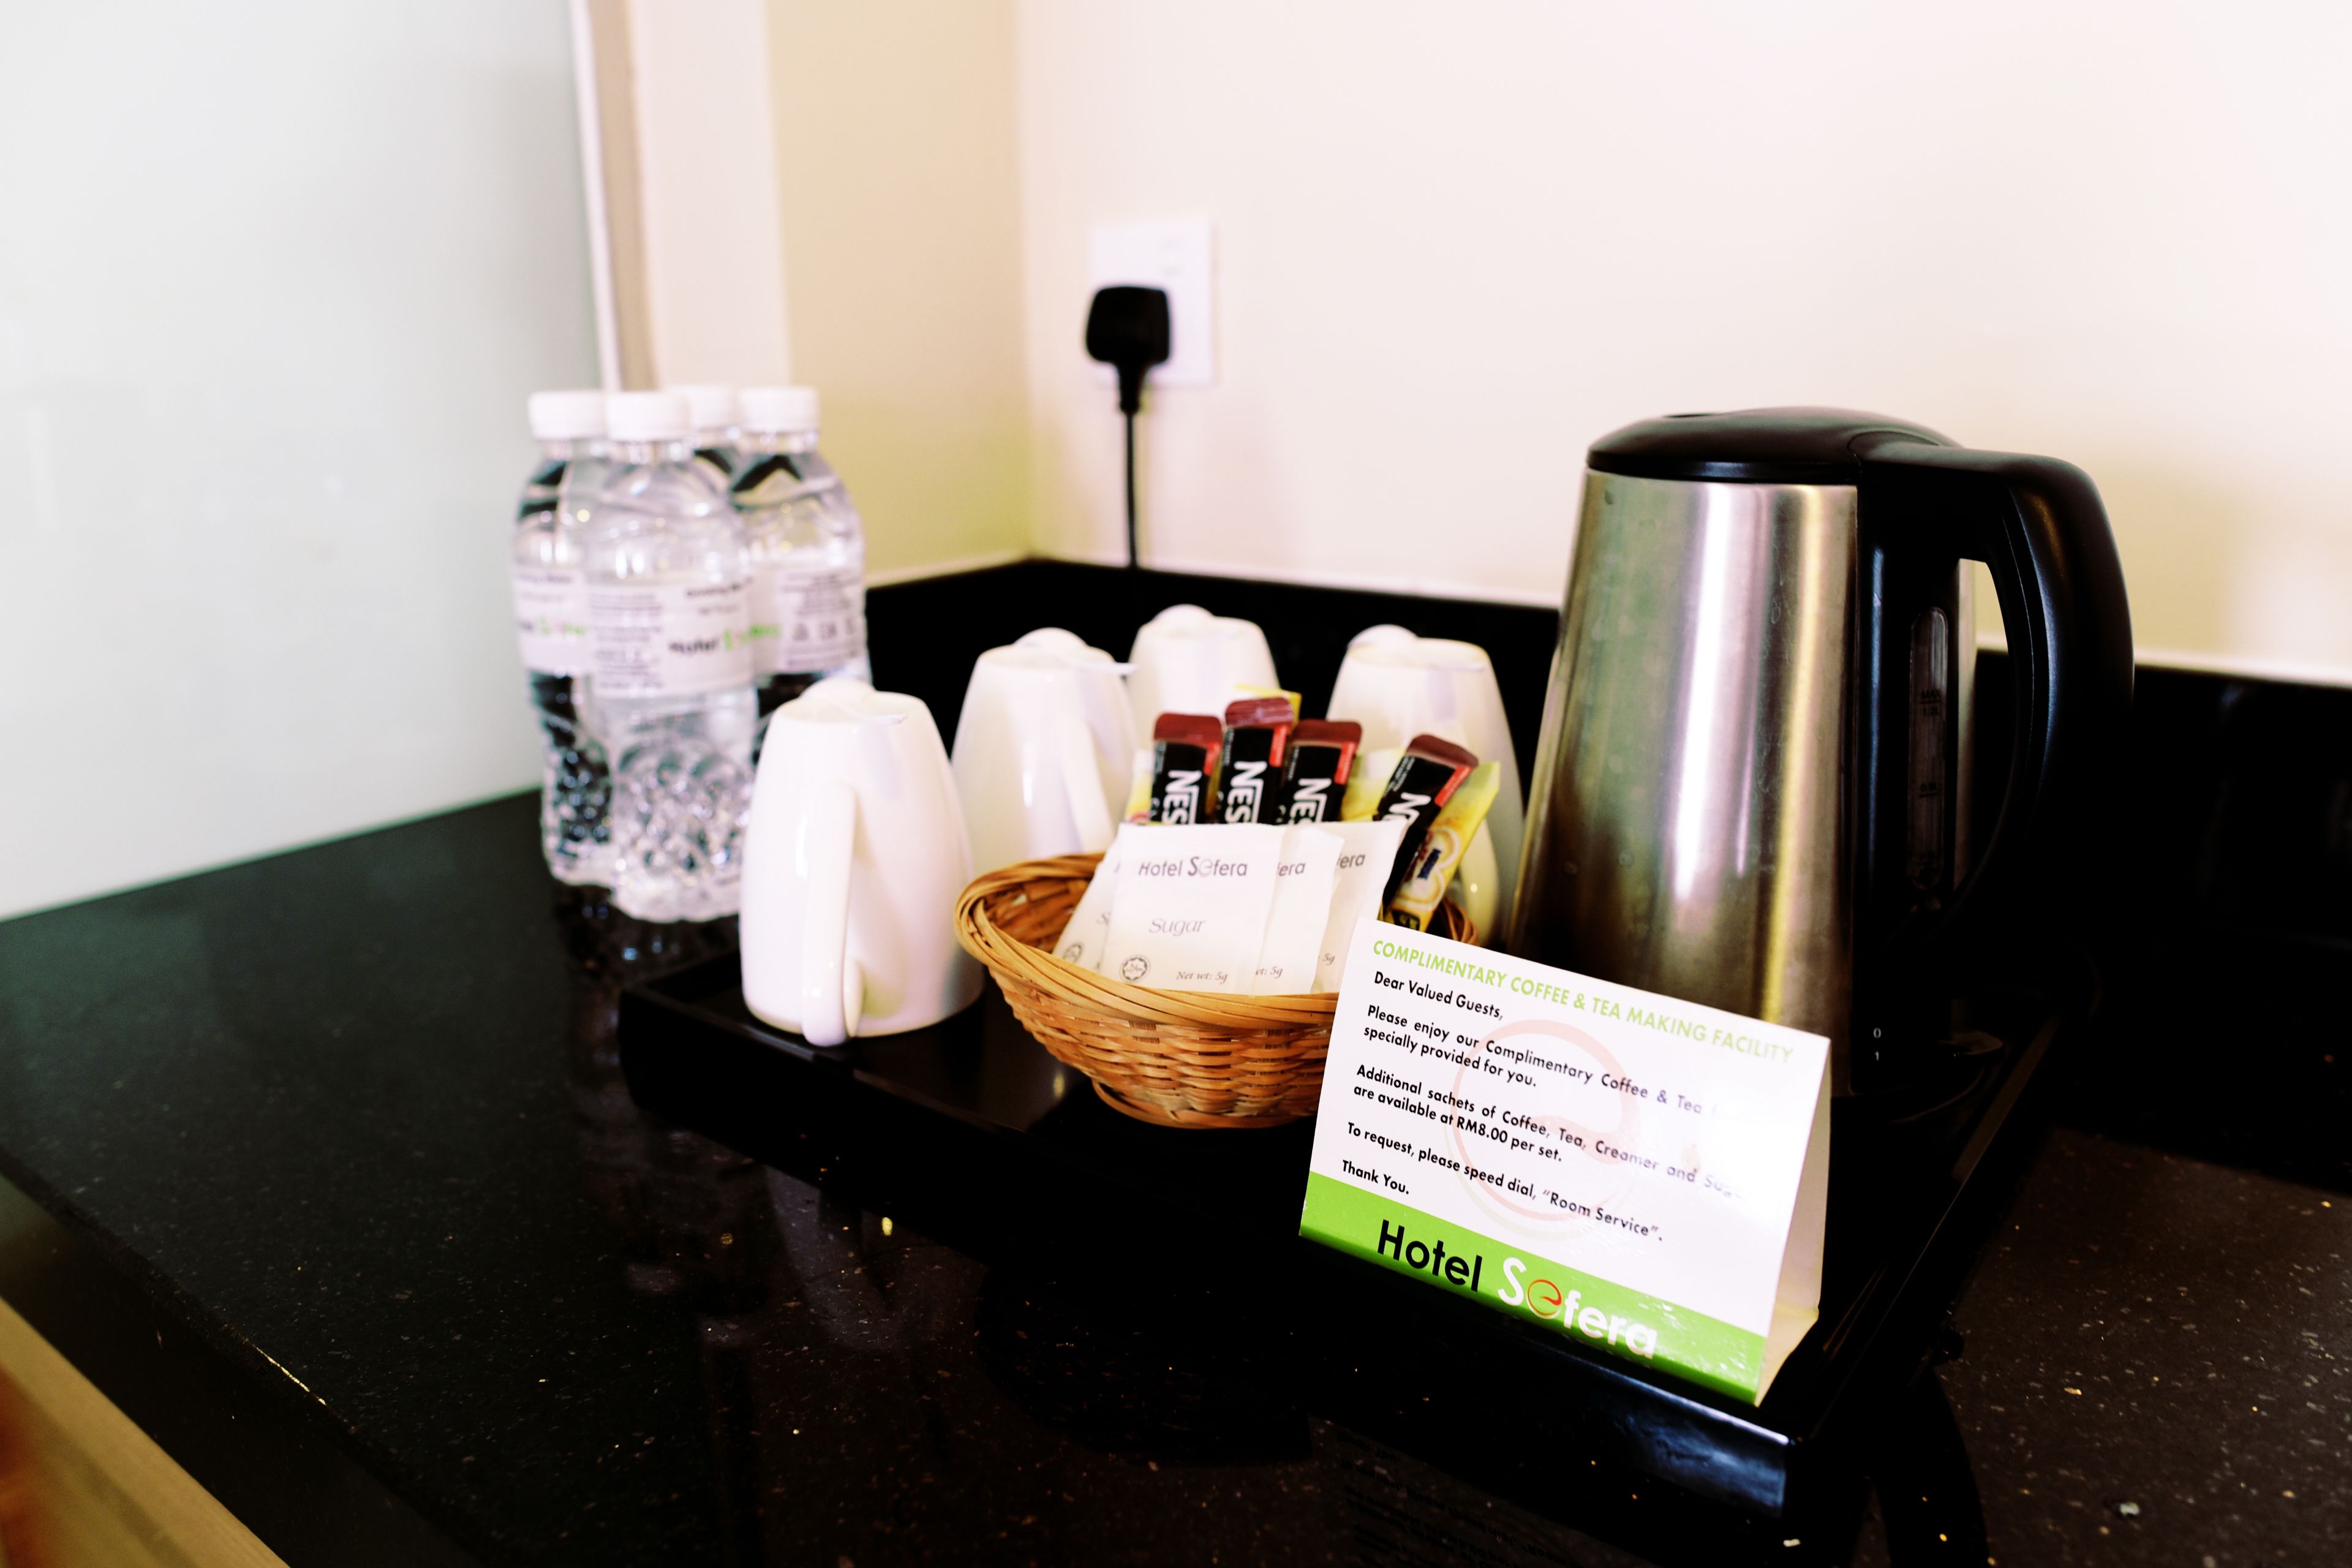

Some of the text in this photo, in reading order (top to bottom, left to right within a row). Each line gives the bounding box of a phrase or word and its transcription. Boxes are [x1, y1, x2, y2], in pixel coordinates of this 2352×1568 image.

[1138, 860, 1183, 877] Hotel
[1149, 918, 1205, 936] Sugar
[1176, 970, 1194, 981] Net
[1215, 970, 1228, 984] 5g
[1270, 965, 1283, 979] 5g
[1373, 940, 1793, 1063] COMPLIMENTARY COFFEE & TEA MAKING FACILITY
[1374, 971, 1503, 1021] Dear Valued Guests,
[1363, 1026, 1536, 1087] specially provided for you.
[1368, 1005, 1702, 1114] Please enjoy our Complimentary Coffee & Tea
[1354, 1085, 1562, 1161] are available at RM8.00 per set.
[1357, 1065, 1422, 1095] Additional
[1428, 1088, 1475, 1112] sachets
[1482, 1106, 1497, 1119] of
[1502, 1111, 1551, 1137] Coffee,
[1559, 1128, 1587, 1150] Tea,
[1596, 1140, 1659, 1170] Creamer
[1667, 1165, 1697, 1182] and
[1342, 1159, 1410, 1195] Thank You.
[1348, 1122, 1361, 1137] To
[1365, 1130, 1414, 1156] request,
[1418, 1147, 1461, 1172] please
[1464, 1166, 1504, 1189] speed
[1507, 1177, 1537, 1200] dial,
[1377, 1219, 1659, 1359] Hotel Sefera
